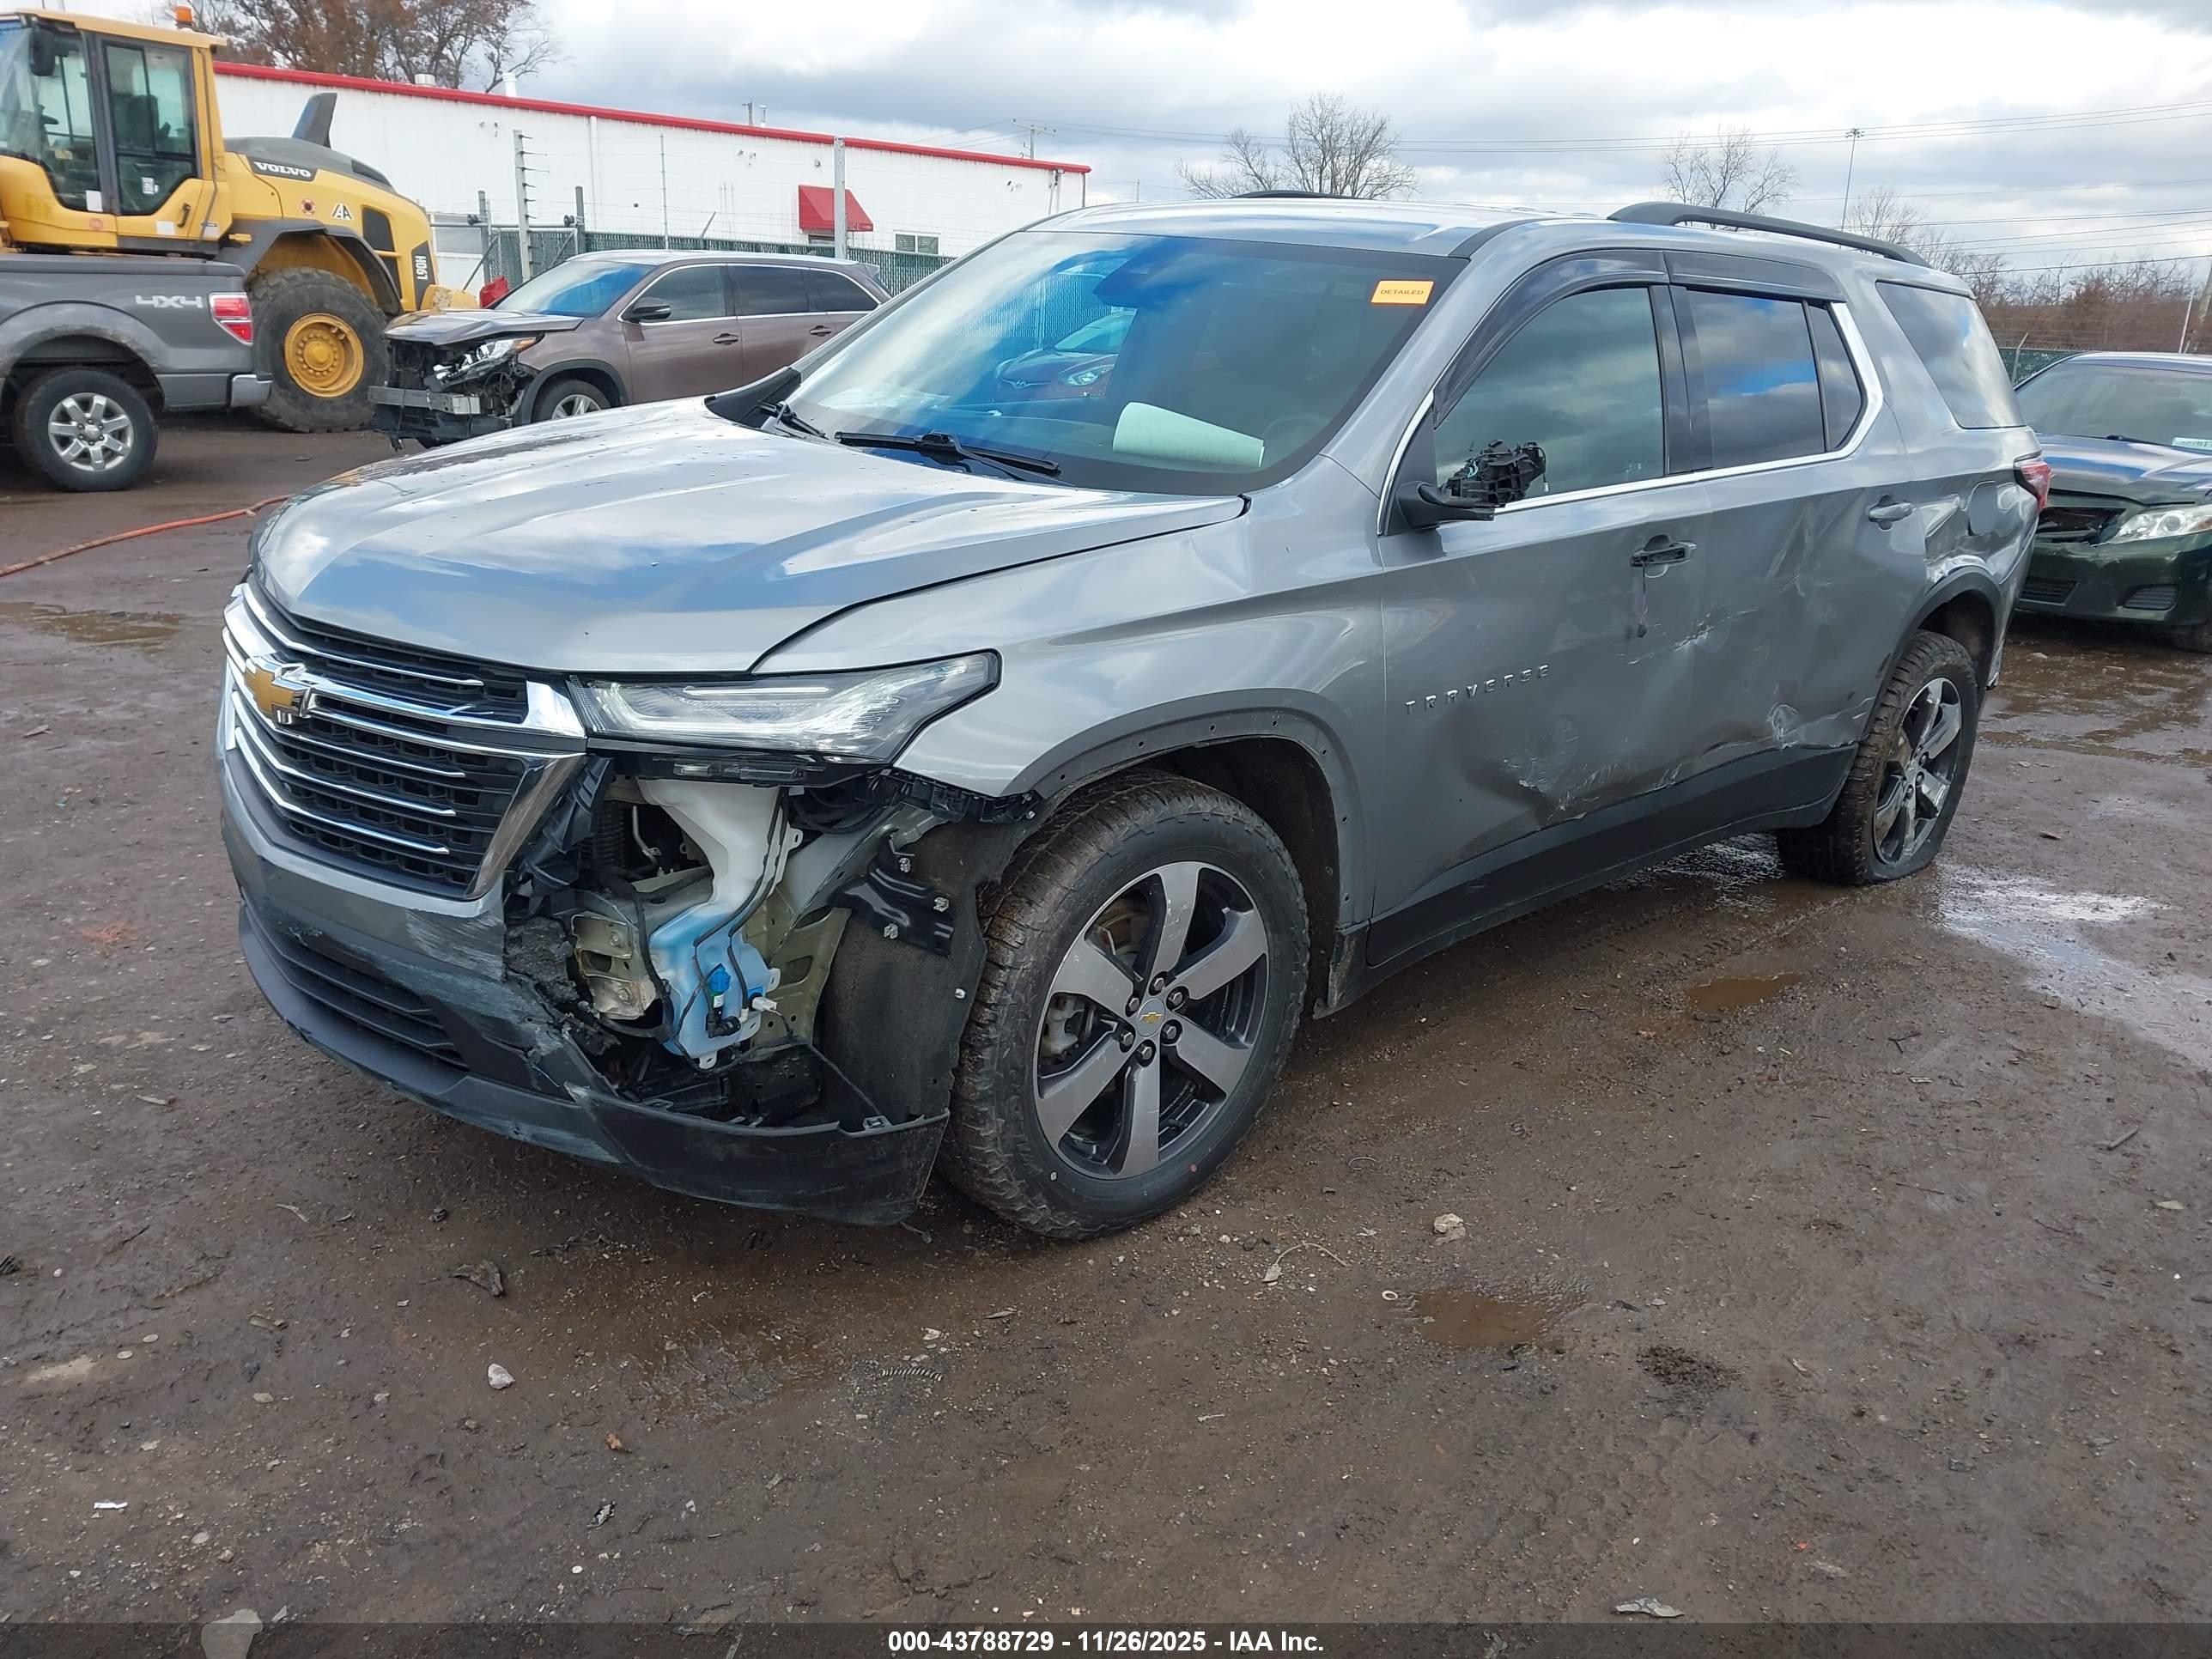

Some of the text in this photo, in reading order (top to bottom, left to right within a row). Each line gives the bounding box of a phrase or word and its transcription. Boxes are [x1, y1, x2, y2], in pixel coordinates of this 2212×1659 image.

[253, 161, 312, 178] VOLVO
[415, 255, 428, 280] L90H
[1404, 664, 1549, 714] TRAVERSE
